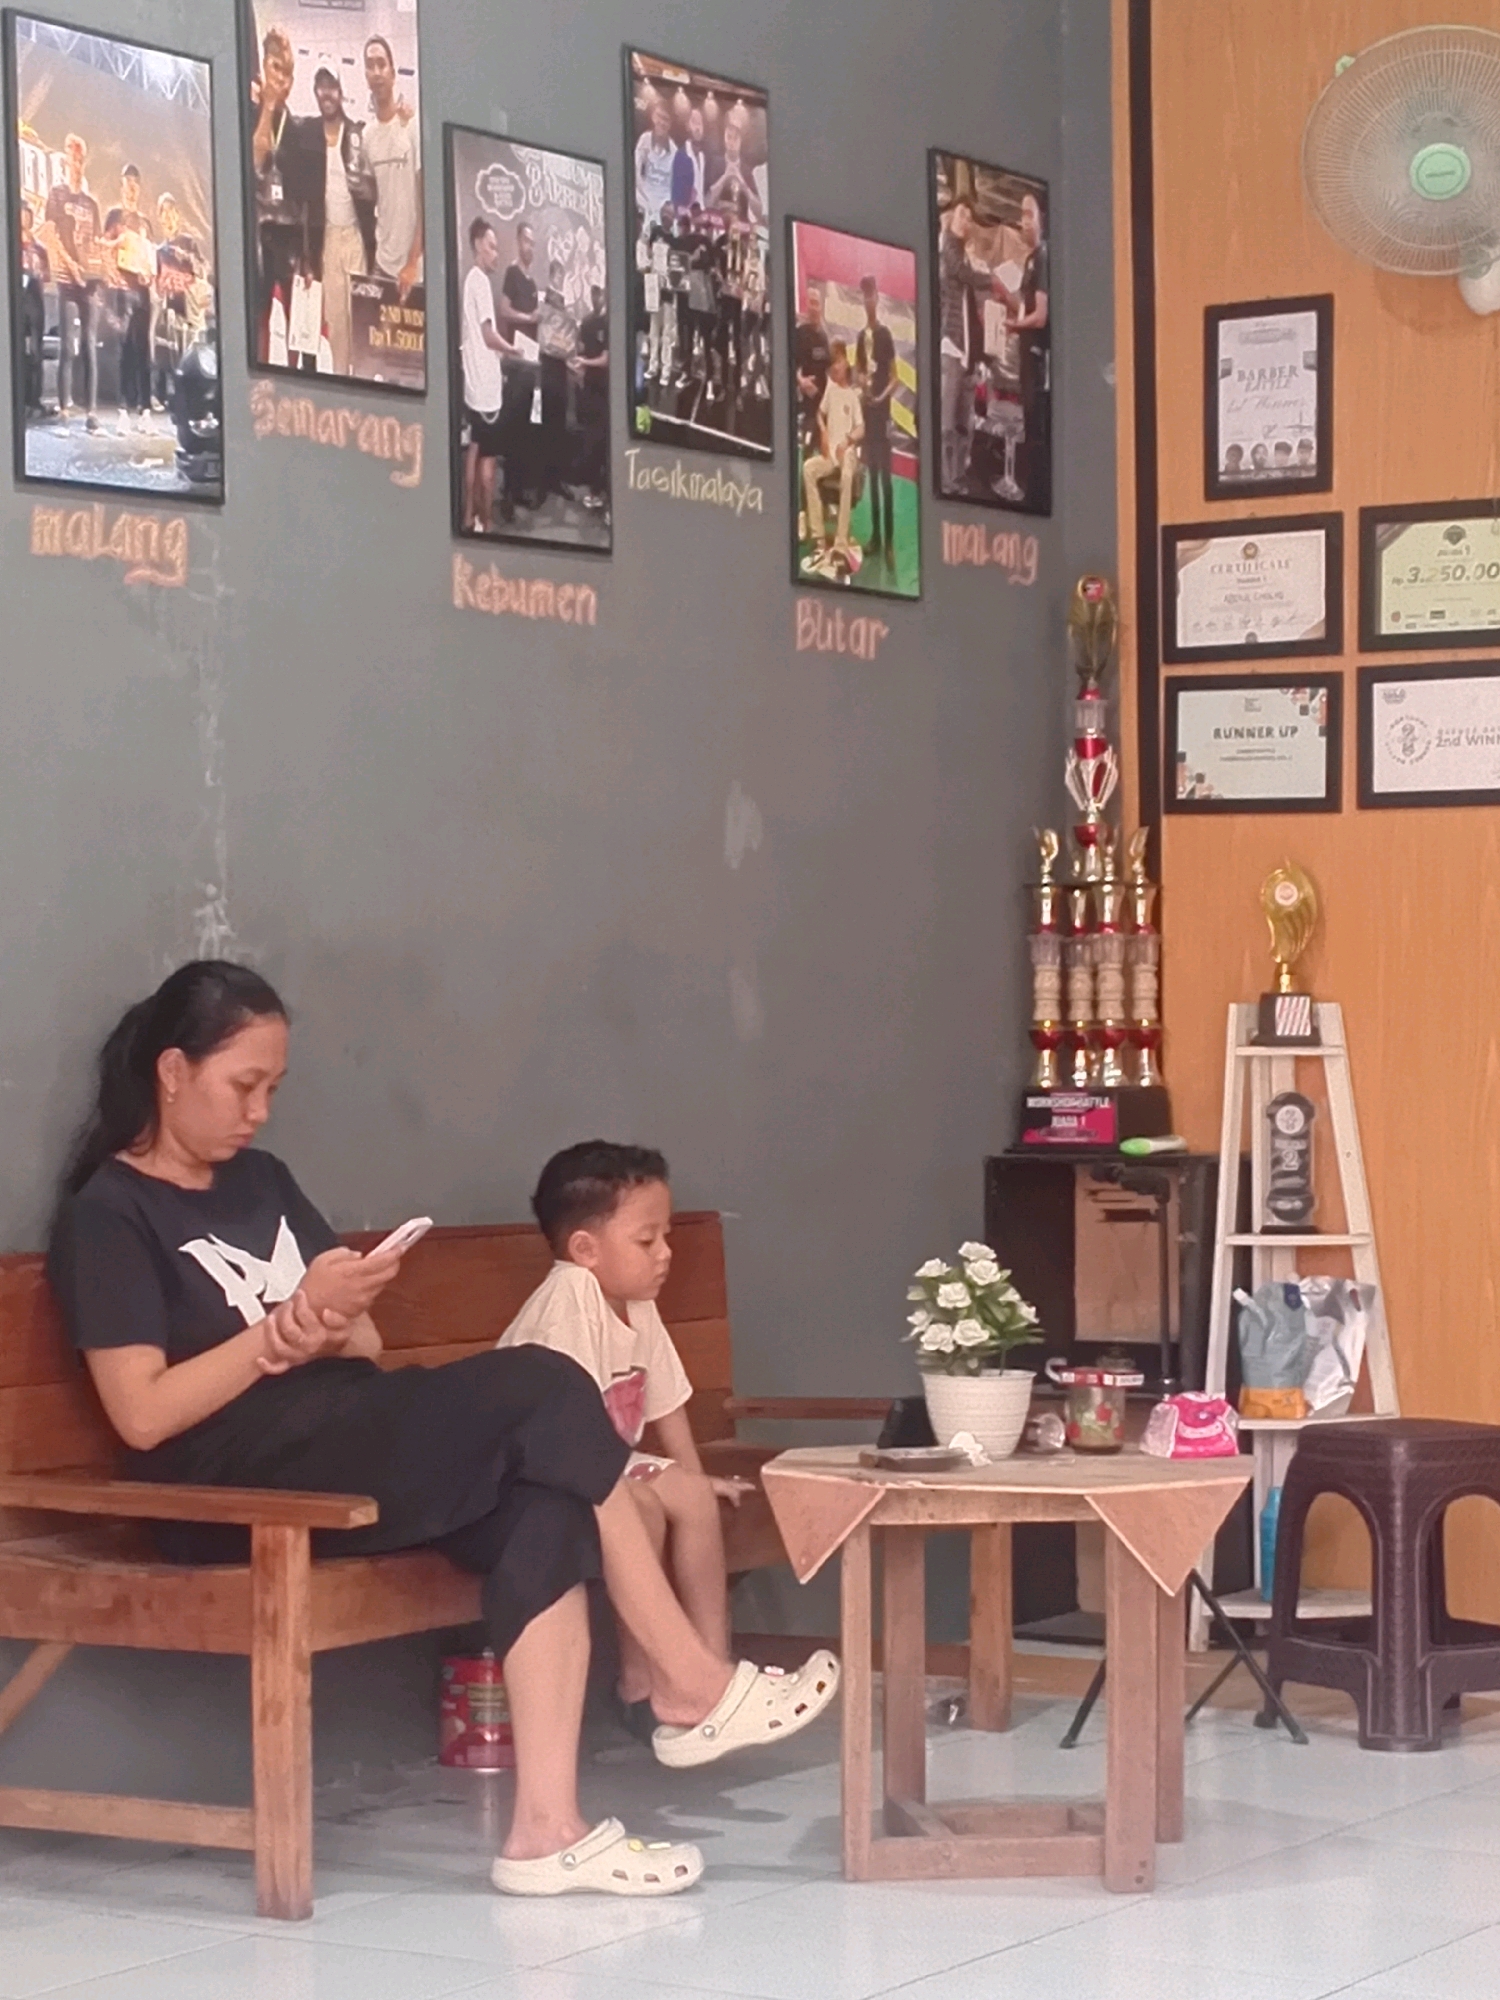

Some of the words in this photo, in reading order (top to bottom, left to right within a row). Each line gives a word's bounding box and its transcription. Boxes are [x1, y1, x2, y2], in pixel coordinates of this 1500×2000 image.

[1236, 364, 1299, 383] BARBER
[624, 448, 763, 516] Tasikmalaya
[1209, 558, 1292, 575] CERTIFICATE
[452, 552, 597, 626] Kebumen
[1213, 725, 1275, 740] RUNNER
[1278, 725, 1299, 738] UP
[1435, 735, 1461, 748] 2nd
